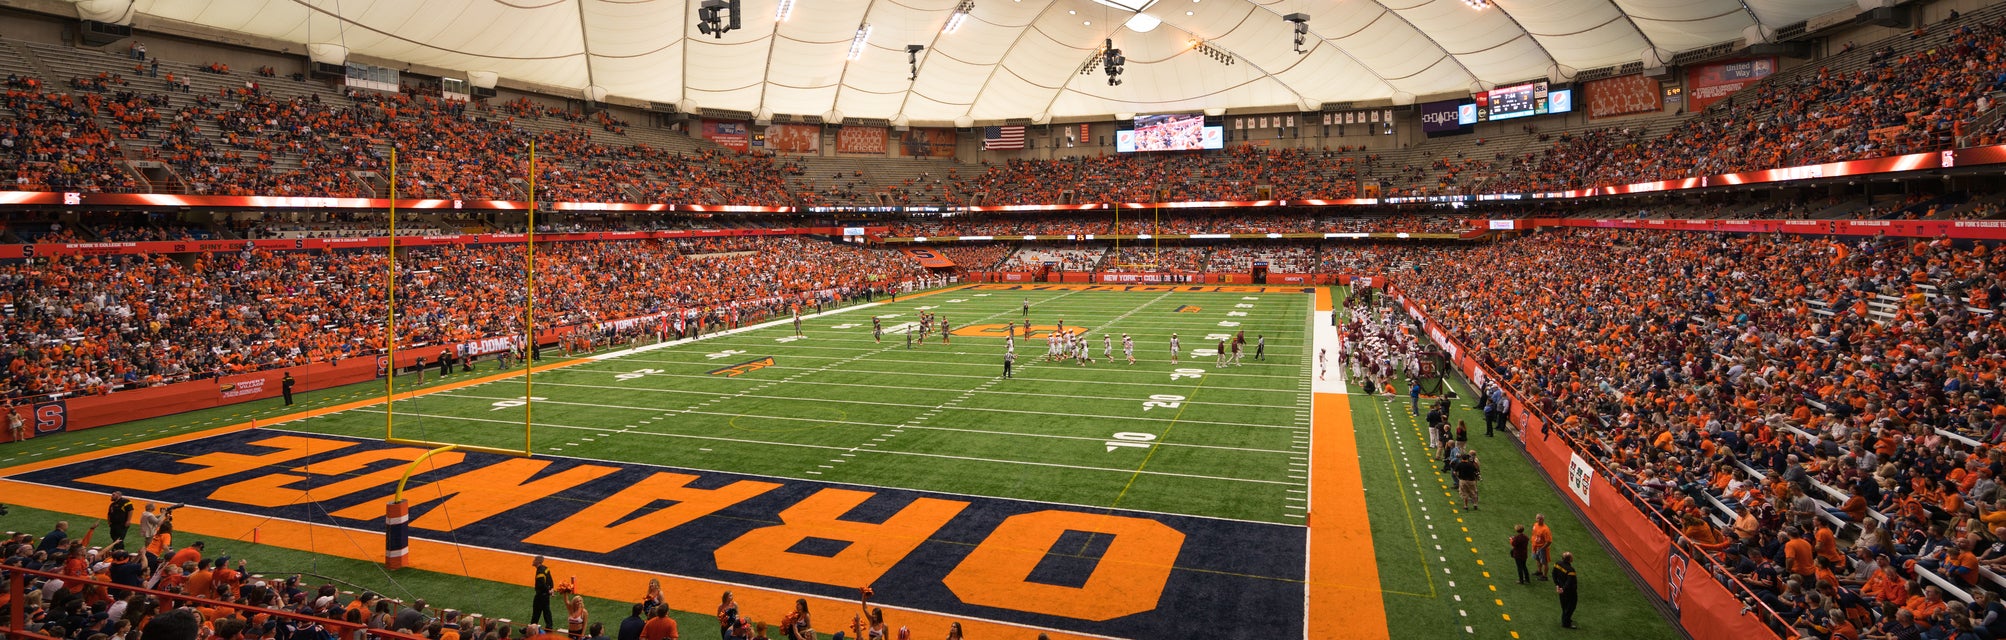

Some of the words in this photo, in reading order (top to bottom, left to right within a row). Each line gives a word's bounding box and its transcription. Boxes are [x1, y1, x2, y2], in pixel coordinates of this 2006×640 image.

[1726, 63, 1750, 71] United
[1735, 69, 1750, 77] Way
[23, 245, 34, 257] S
[1143, 395, 1186, 409] 20
[37, 405, 64, 432] S
[1105, 432, 1157, 449] 10
[73, 435, 1186, 621] ORANGE
[1669, 554, 1686, 610] S
